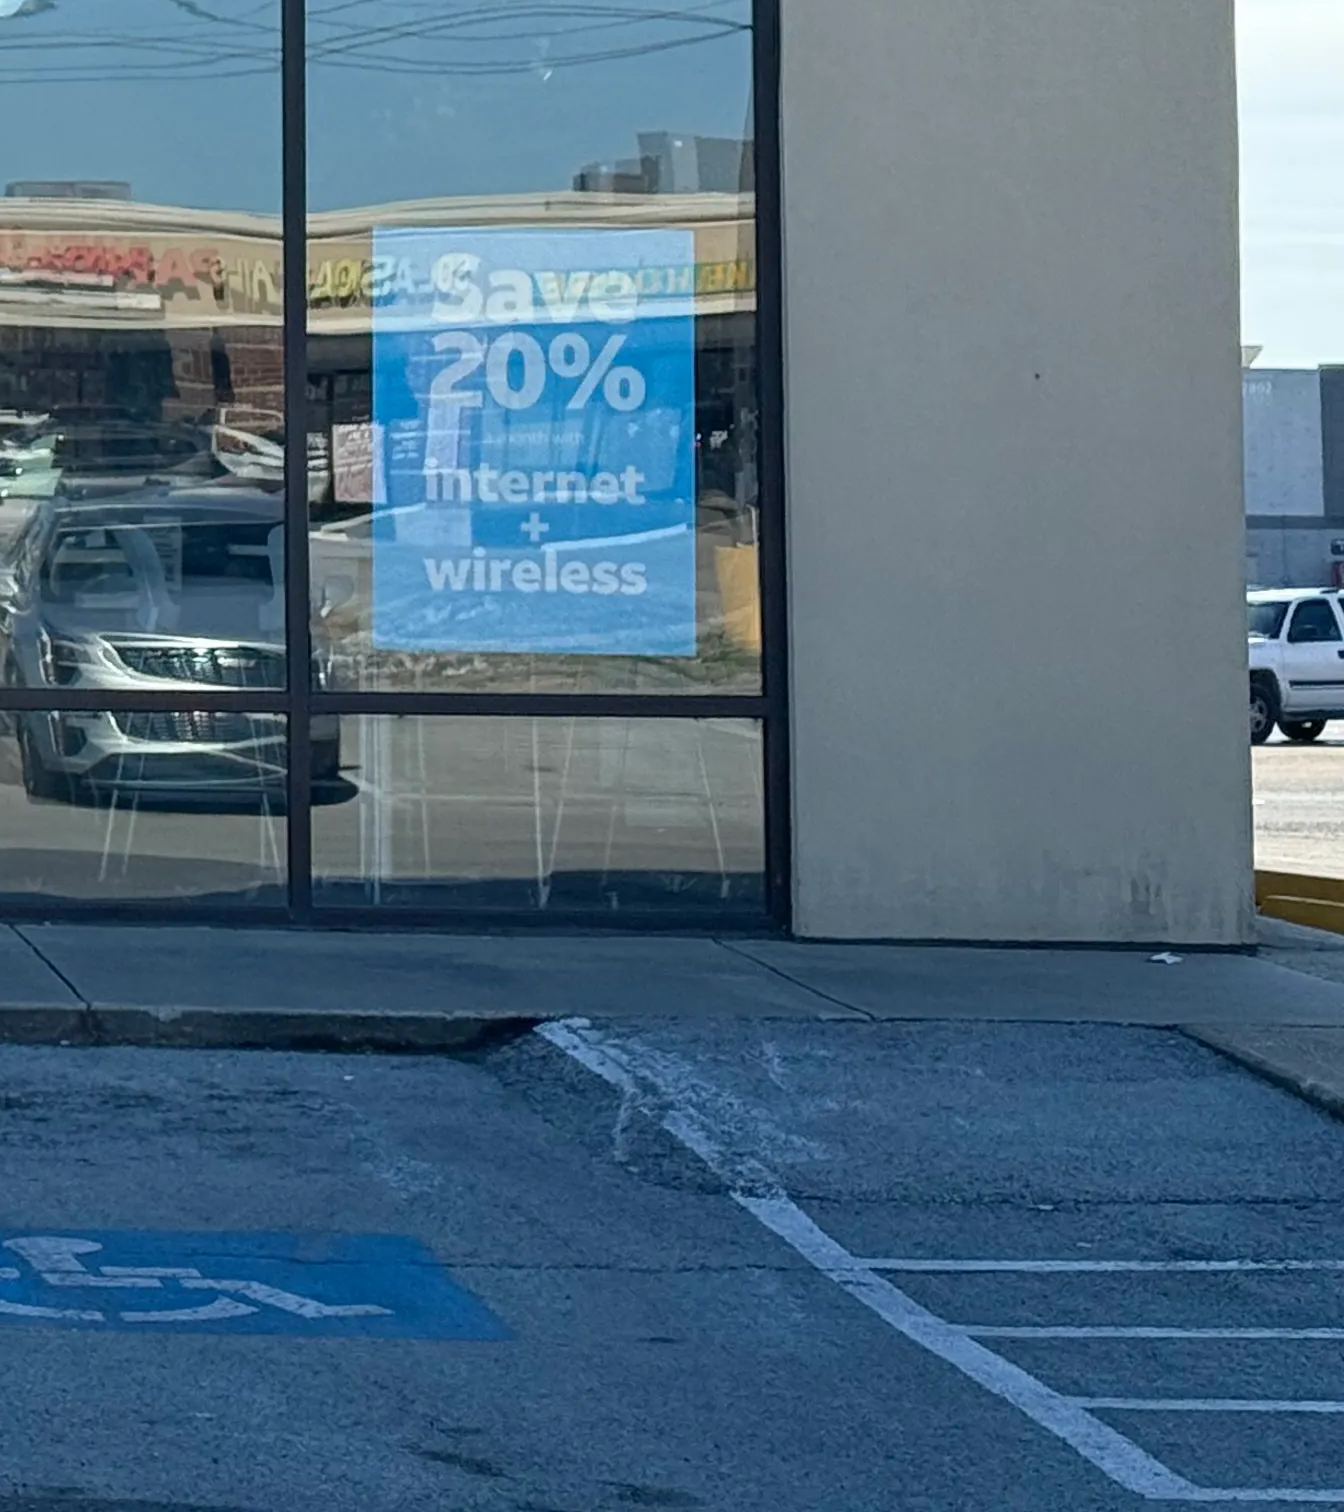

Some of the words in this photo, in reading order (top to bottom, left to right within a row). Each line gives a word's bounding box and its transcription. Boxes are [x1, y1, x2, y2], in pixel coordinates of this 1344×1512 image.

[430, 253, 638, 324] Save
[429, 332, 647, 412] 20%
[424, 457, 646, 505] internet
[424, 547, 648, 596] wireless
